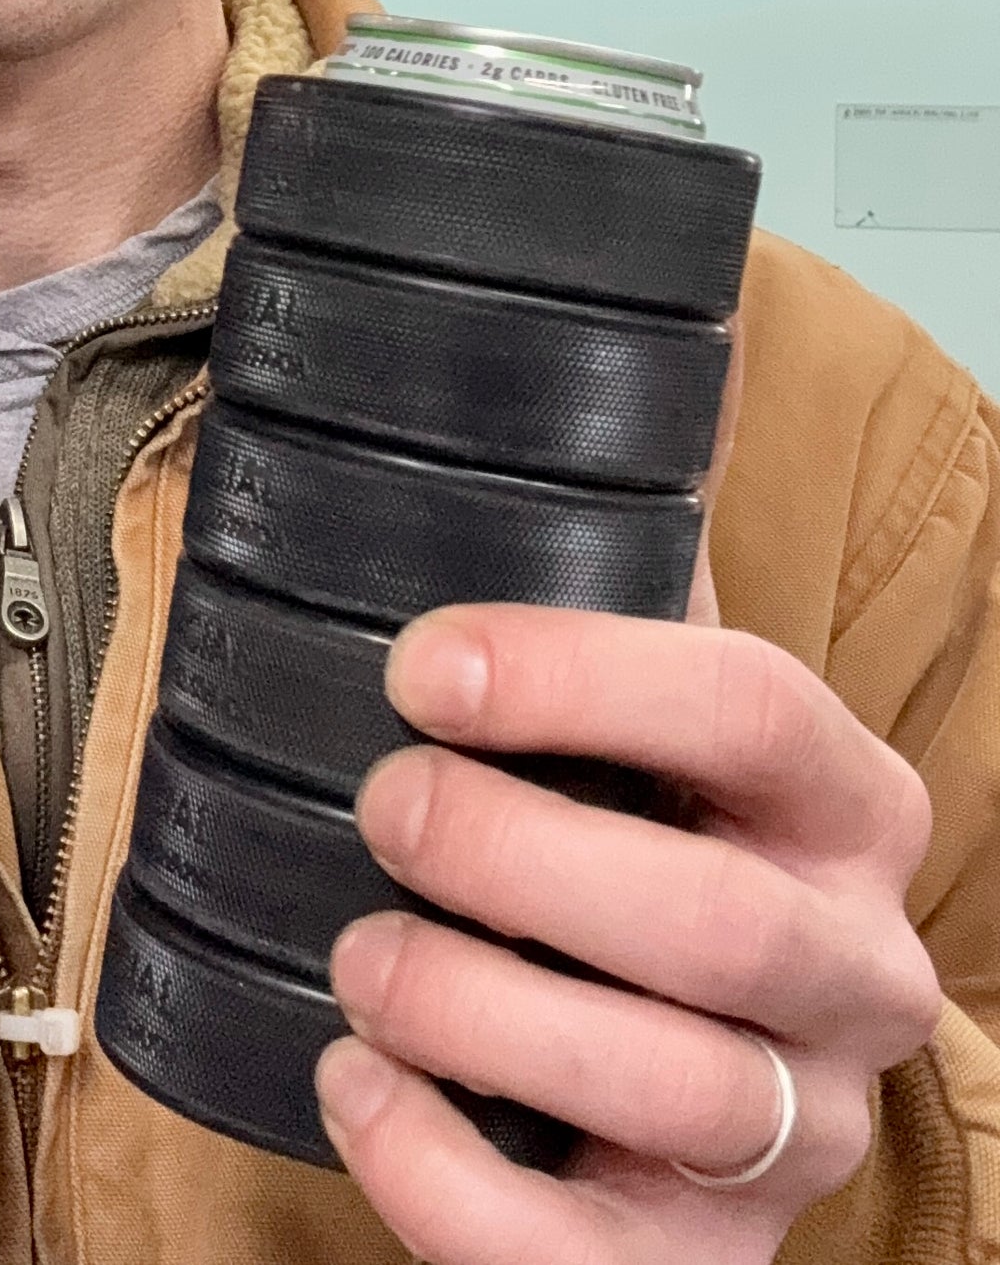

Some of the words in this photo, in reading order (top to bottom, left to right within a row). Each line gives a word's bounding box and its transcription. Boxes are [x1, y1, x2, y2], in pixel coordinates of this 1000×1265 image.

[360, 45, 384, 60] 100
[385, 47, 459, 72] CALORIES
[480, 61, 505, 81] 2g
[651, 91, 680, 112] FREE
